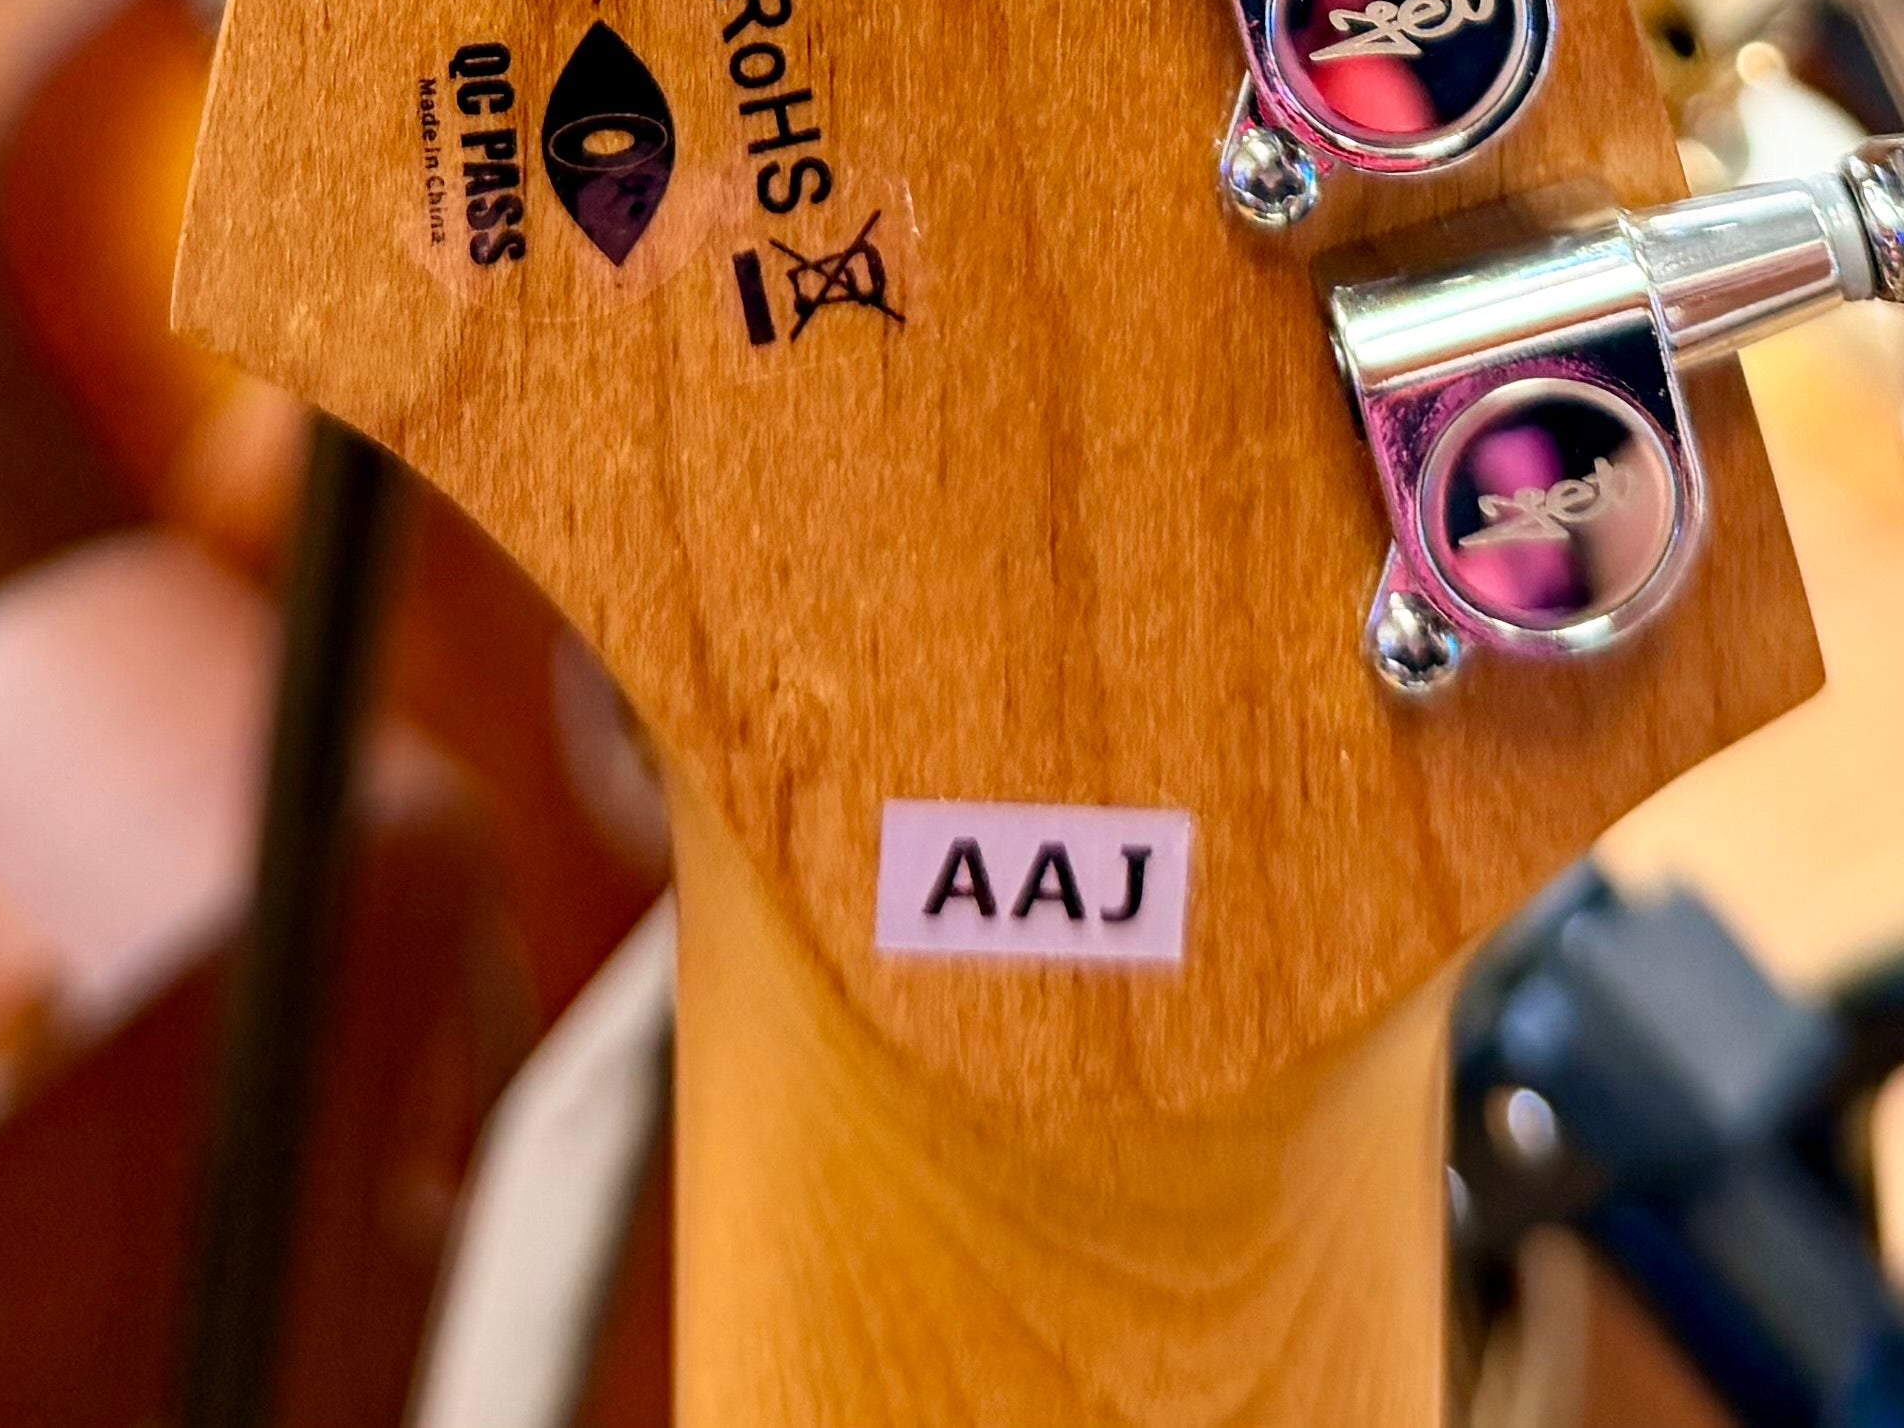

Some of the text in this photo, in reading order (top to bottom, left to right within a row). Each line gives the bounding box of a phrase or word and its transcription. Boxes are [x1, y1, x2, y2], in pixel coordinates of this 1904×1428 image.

[418, 78, 441, 142] Made
[449, 42, 526, 266] QC PASS
[426, 175, 446, 246] China
[922, 837, 1153, 922] AAJ
